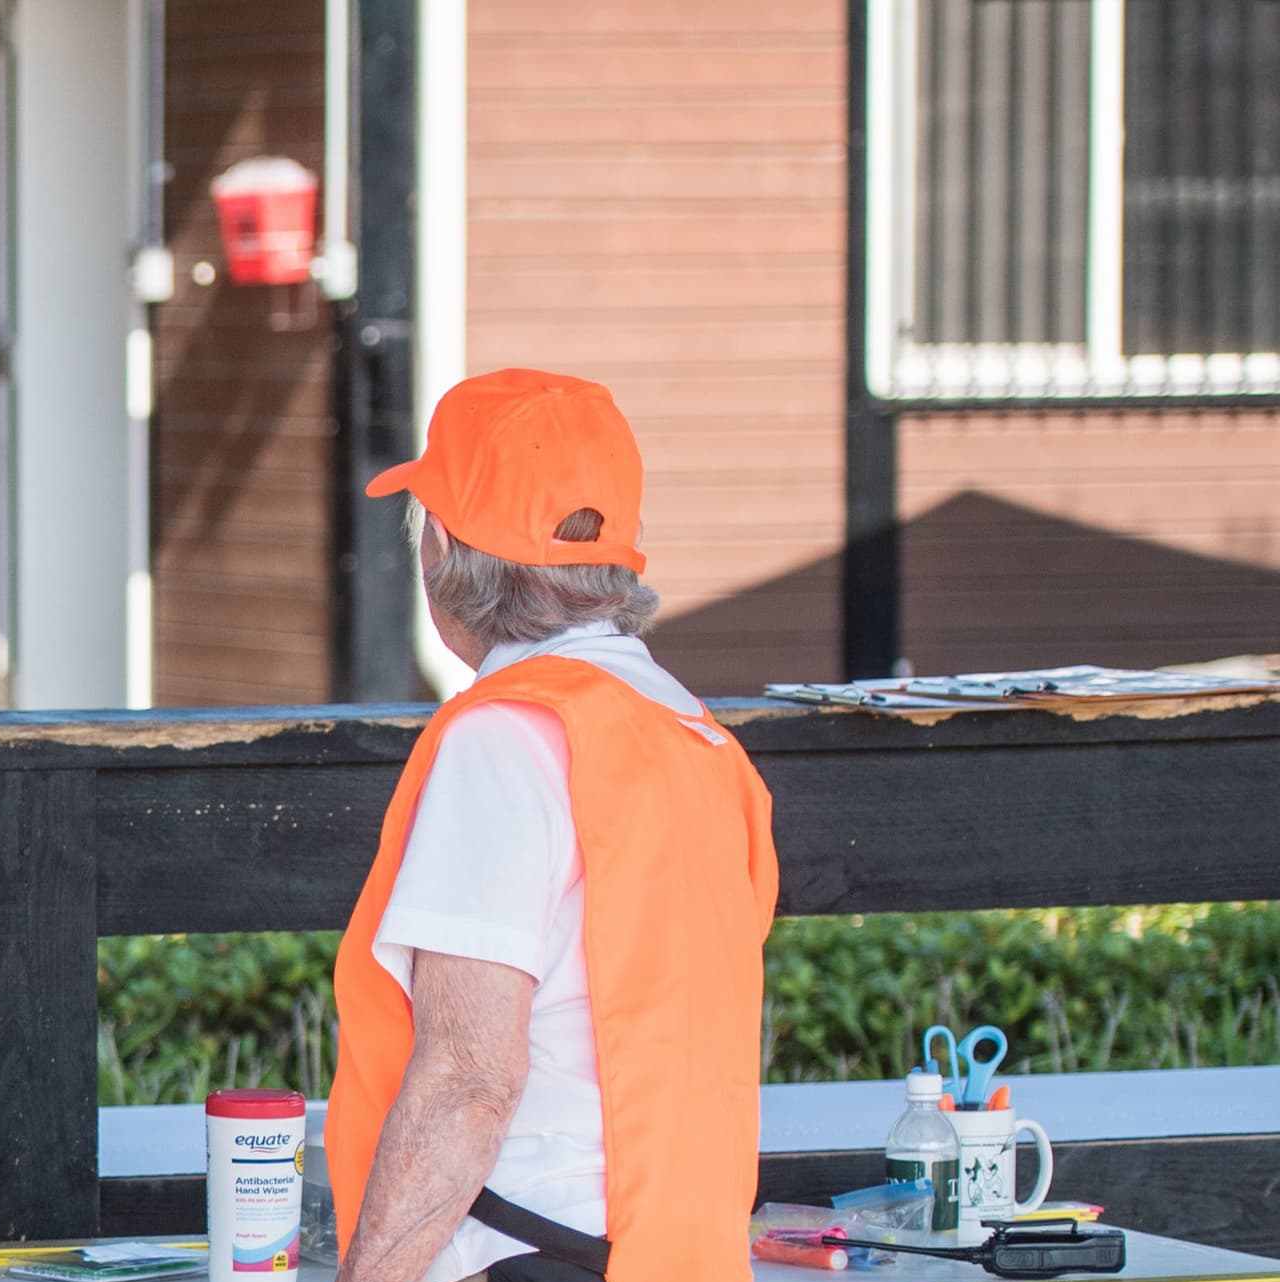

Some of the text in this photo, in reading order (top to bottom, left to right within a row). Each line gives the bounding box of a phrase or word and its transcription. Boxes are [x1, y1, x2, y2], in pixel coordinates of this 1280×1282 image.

[235, 1132, 290, 1149] equate
[235, 1176, 295, 1185] Antibacterial
[235, 1186, 289, 1197] Hand Wipes
